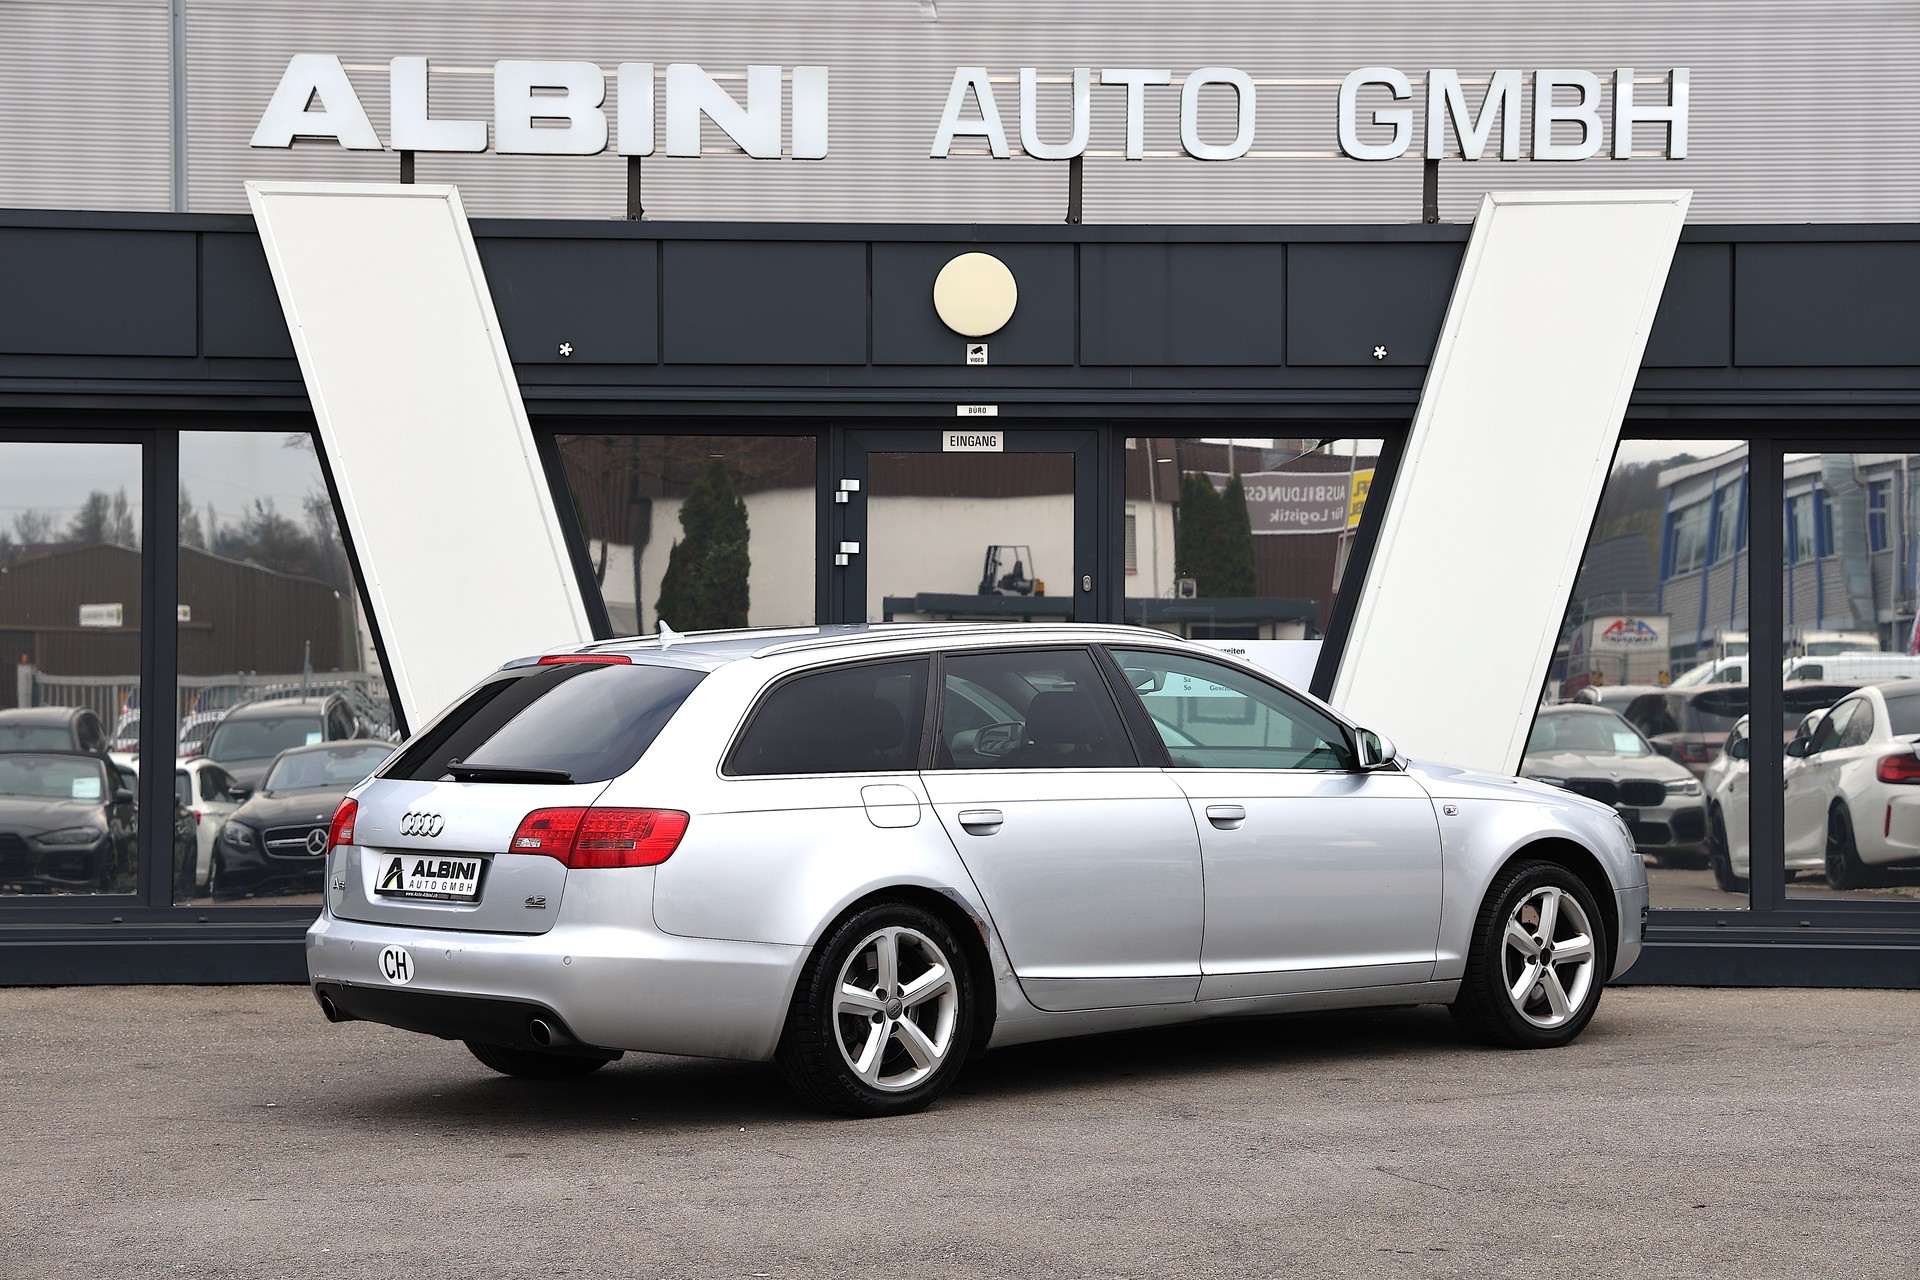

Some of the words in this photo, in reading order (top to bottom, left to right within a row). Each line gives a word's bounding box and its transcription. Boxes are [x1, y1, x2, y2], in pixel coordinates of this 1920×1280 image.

[250, 54, 829, 160] ALBINI
[930, 67, 1257, 161] AUTO
[1337, 67, 1690, 161] GMBH
[968, 406, 987, 414] BÜRO
[950, 435, 997, 447] EINGANG
[411, 859, 477, 880] ALBINI
[409, 880, 437, 890] AUTO
[441, 881, 473, 892] GMBH
[384, 949, 409, 980] CH
